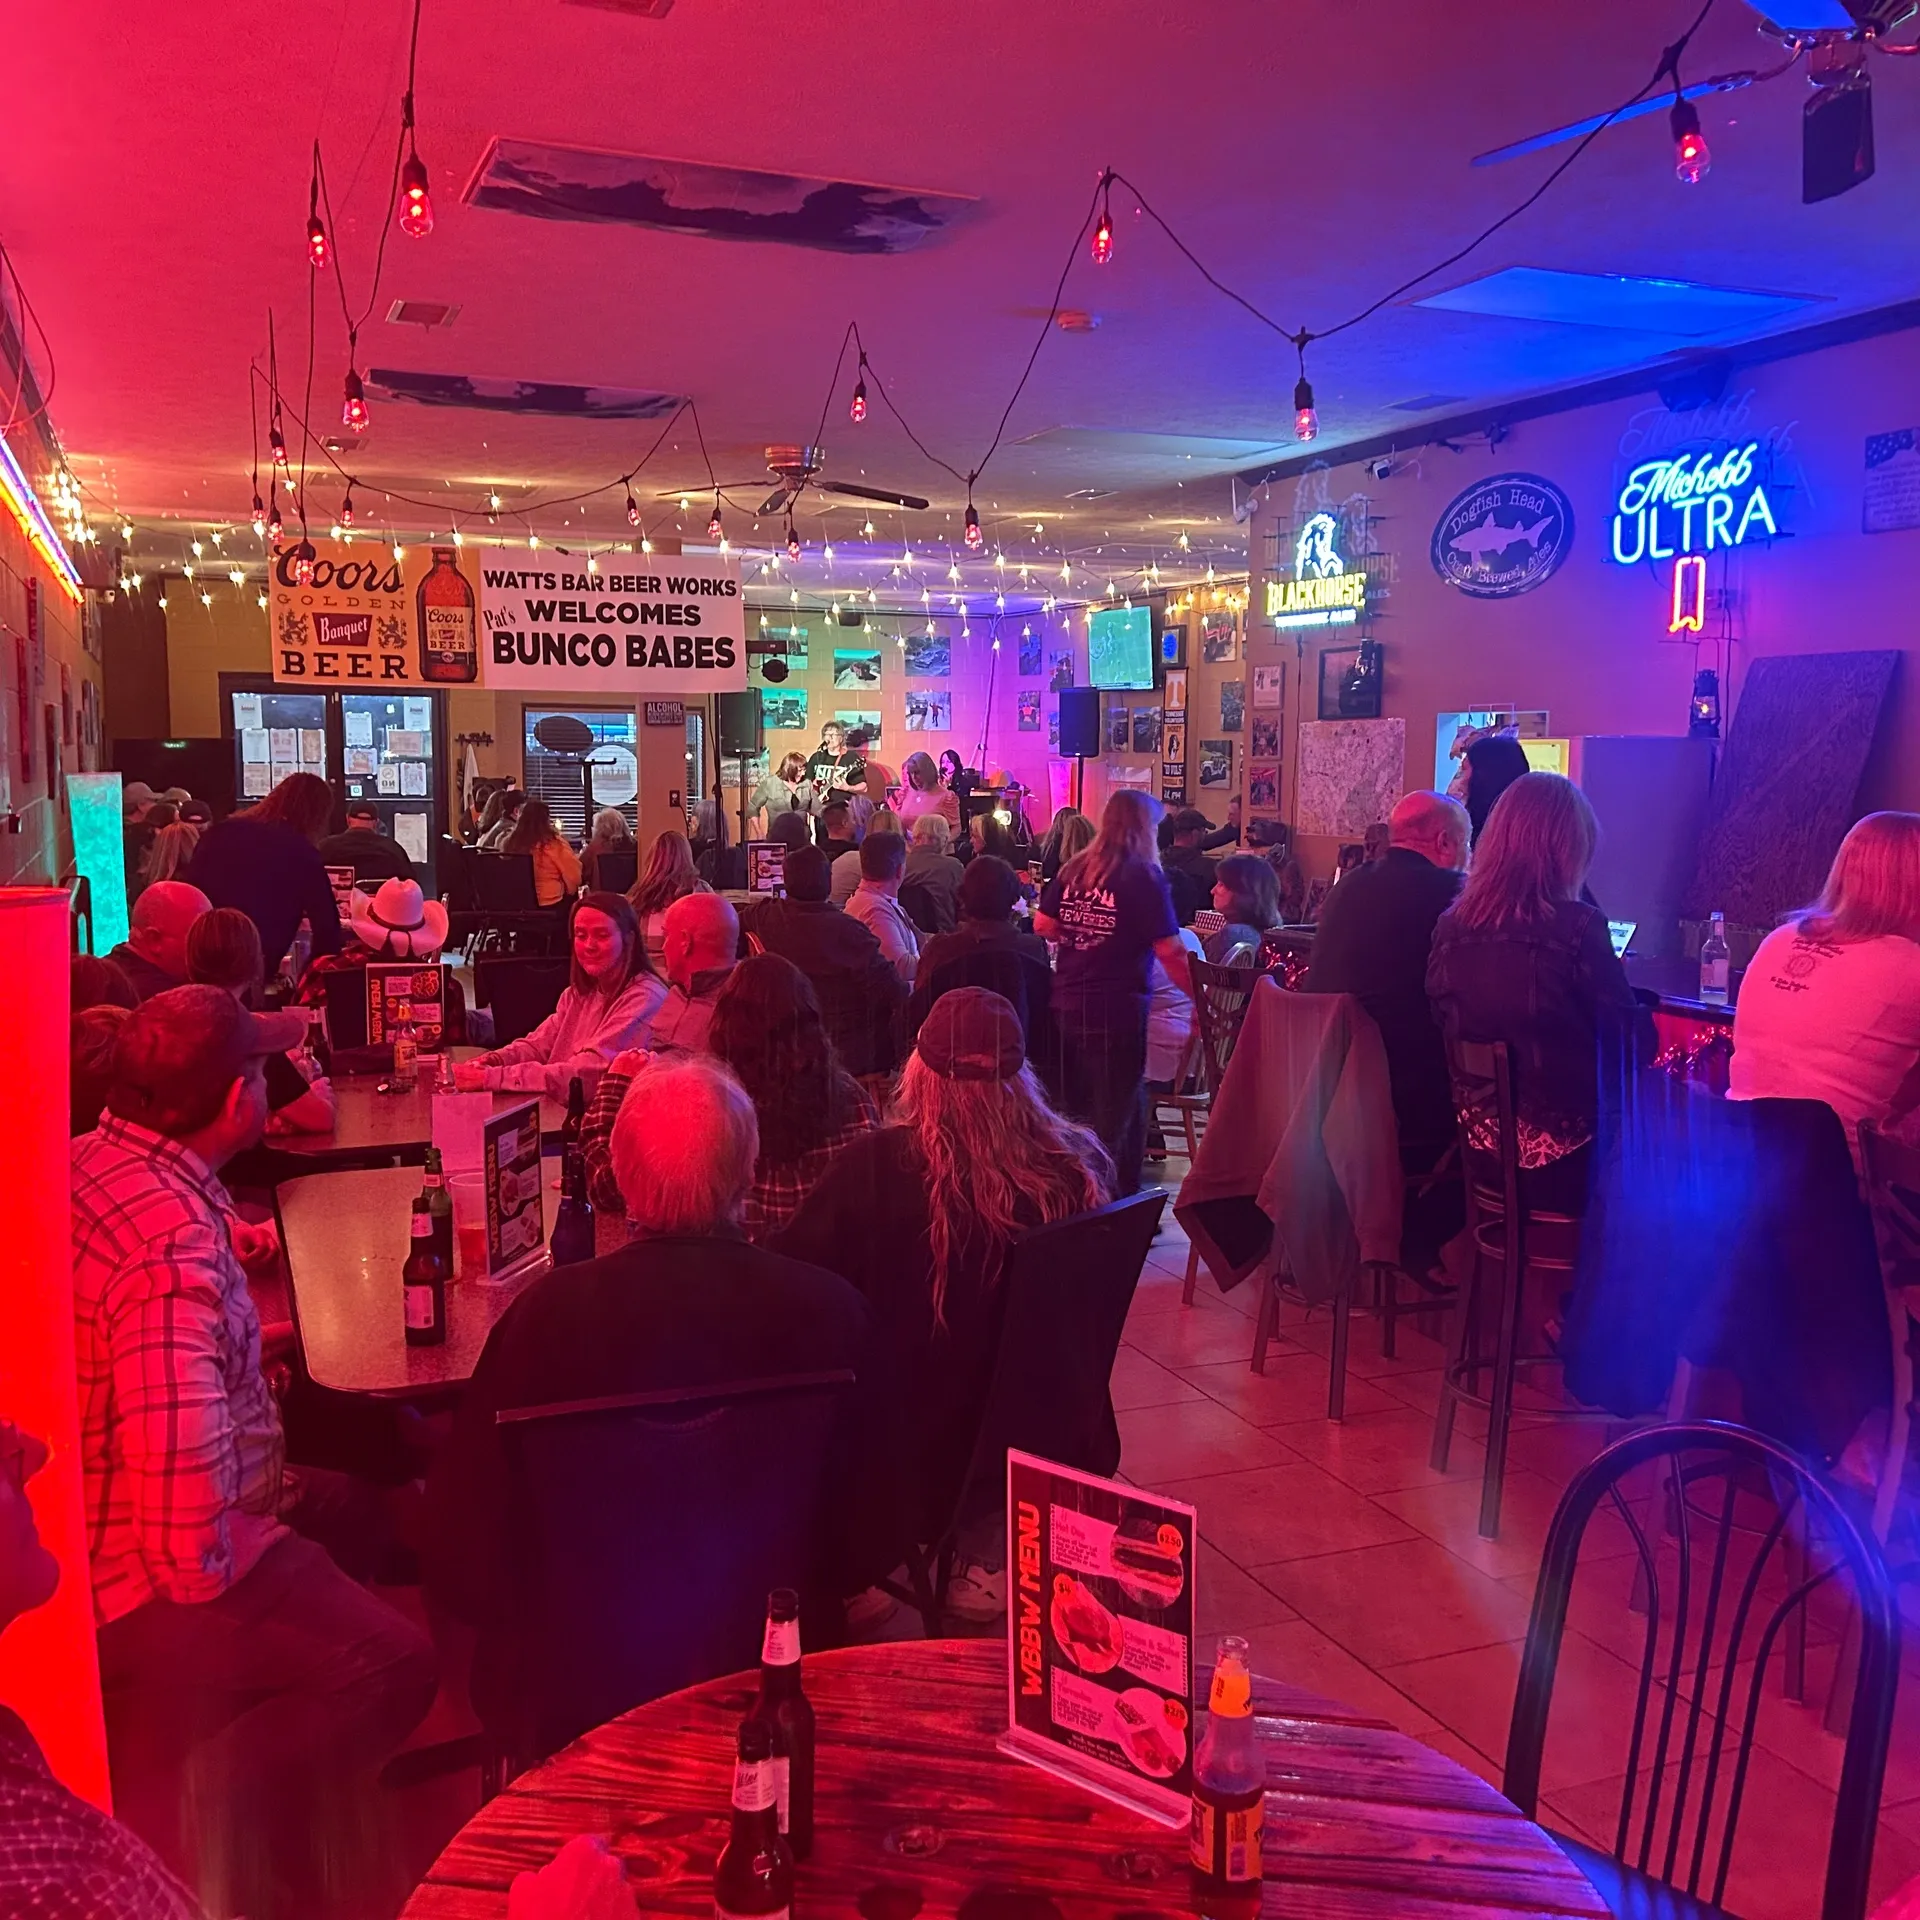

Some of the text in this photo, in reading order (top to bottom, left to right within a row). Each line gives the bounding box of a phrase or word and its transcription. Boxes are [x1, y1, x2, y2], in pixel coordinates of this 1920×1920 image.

[1450, 489, 1546, 535] Dogfish Head
[1613, 485, 1777, 564] ULTRA
[273, 543, 405, 594] Coors
[1446, 540, 1552, 584] Craft Brewed Ales
[483, 570, 557, 591] WATTS
[561, 573, 605, 592] BAR
[609, 576, 662, 595] BEER
[665, 577, 737, 597] WORKS
[1266, 572, 1367, 616] BLACKHORSE
[276, 593, 406, 611] GOLDEN
[427, 608, 464, 624] Coors
[524, 599, 702, 627] WELCOMES
[320, 617, 369, 643] Banquet
[482, 605, 517, 631] Pat's
[429, 640, 466, 650] BEER
[492, 630, 737, 669] BUNCO BABES
[280, 650, 409, 680] BEER
[647, 702, 683, 713] ALCOHOL
[1074, 900, 1092, 912] THE
[1018, 1501, 1043, 1695] WBBW MENU
